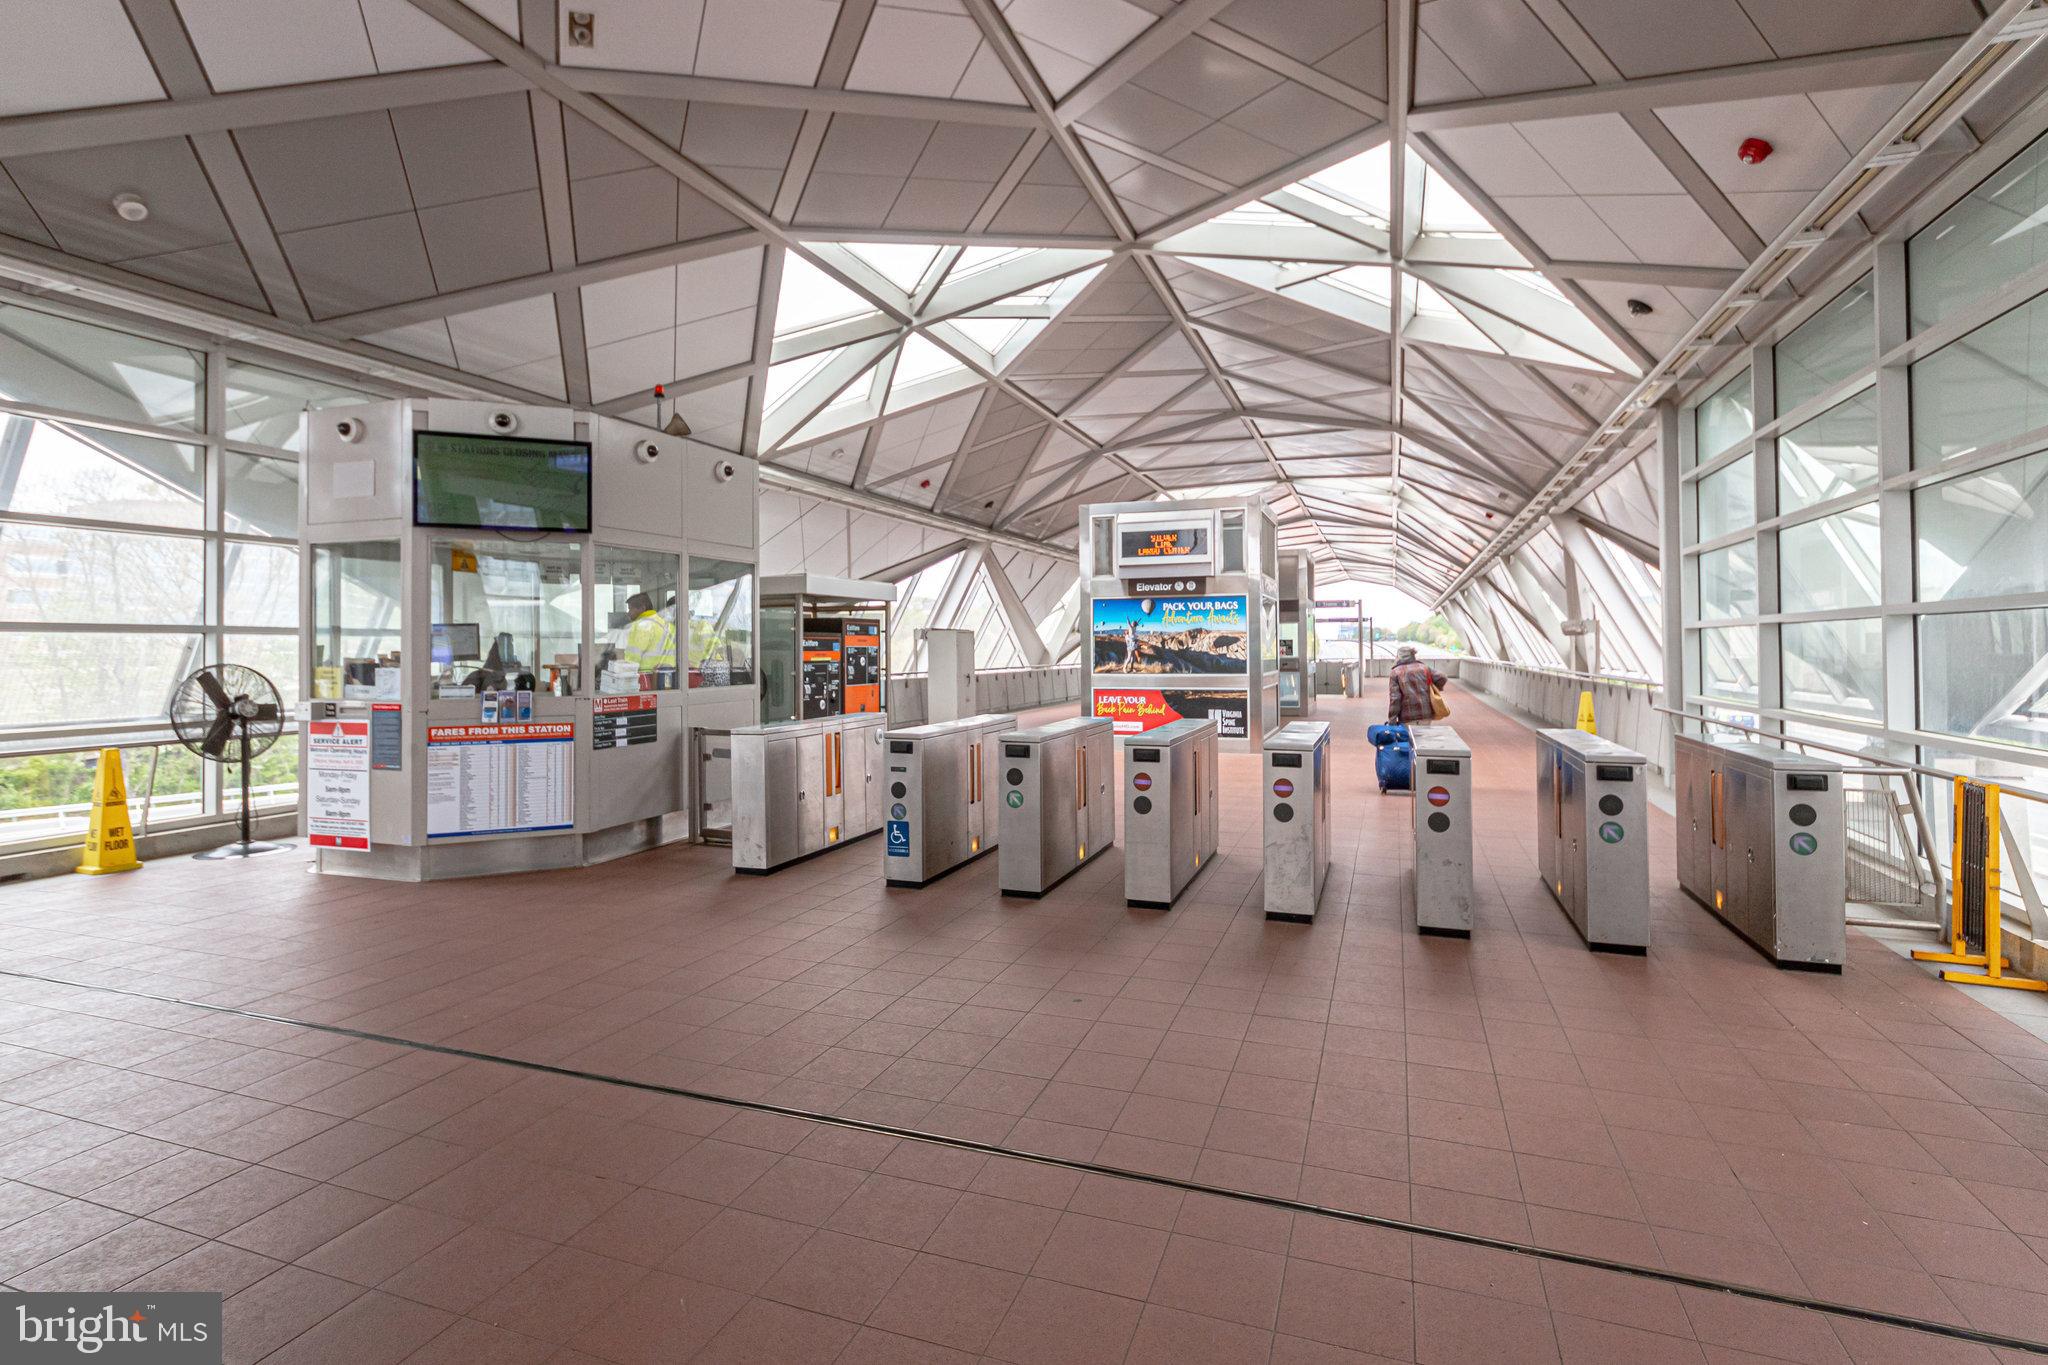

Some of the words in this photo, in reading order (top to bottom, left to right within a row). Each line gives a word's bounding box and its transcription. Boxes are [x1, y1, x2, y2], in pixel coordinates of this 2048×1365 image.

[1136, 582, 1172, 592] Elevator
[1163, 602, 1186, 610] PACK
[1187, 601, 1213, 610] YOUR
[1215, 601, 1239, 609] BAGS
[1098, 695, 1122, 704] LEAVE
[1123, 696, 1147, 704] YOUR
[1137, 703, 1166, 716] Behind
[430, 728, 465, 737] FARES
[468, 727, 499, 736] FROM
[502, 726, 526, 734] THIS
[528, 725, 571, 733] STATION
[108, 827, 125, 837] WET
[104, 839, 129, 851] FLOOR
